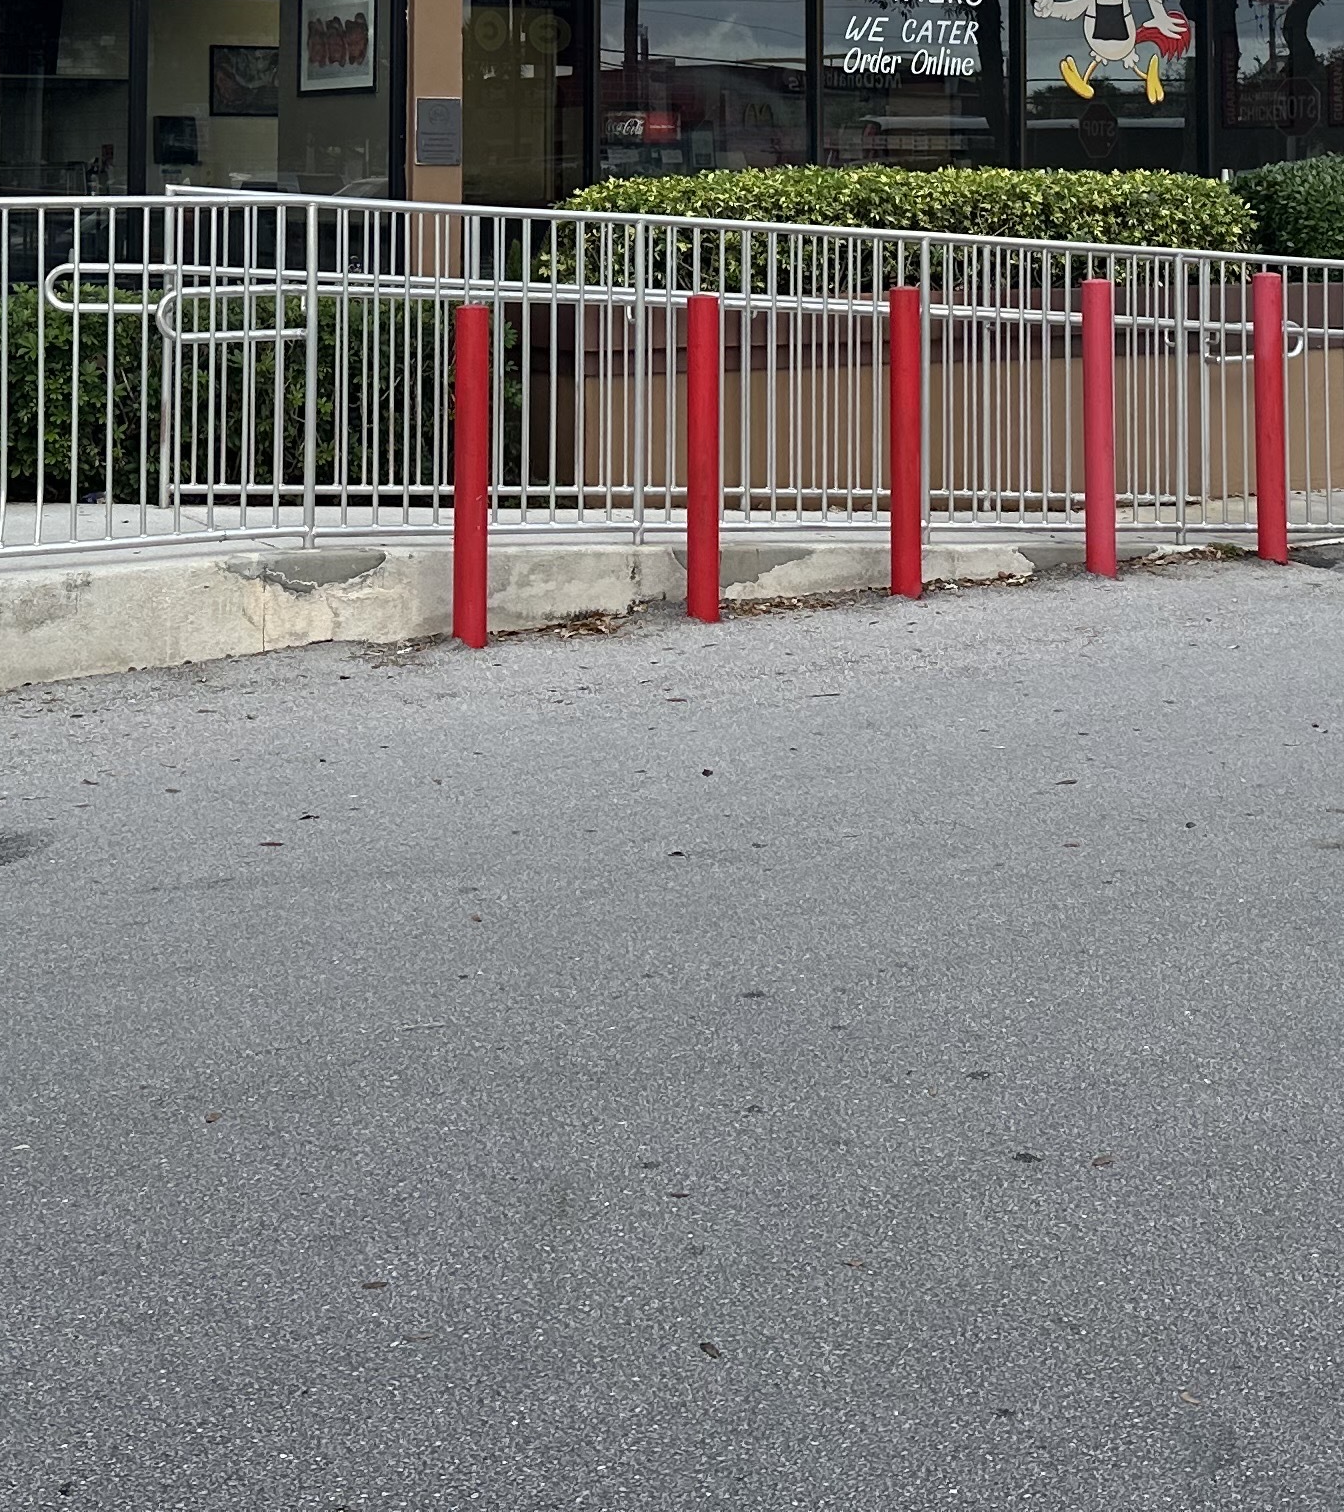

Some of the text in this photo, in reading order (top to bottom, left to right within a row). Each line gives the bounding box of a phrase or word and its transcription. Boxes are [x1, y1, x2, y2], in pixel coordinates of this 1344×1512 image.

[845, 15, 979, 45] WE CATER
[843, 47, 975, 76] Order Online
